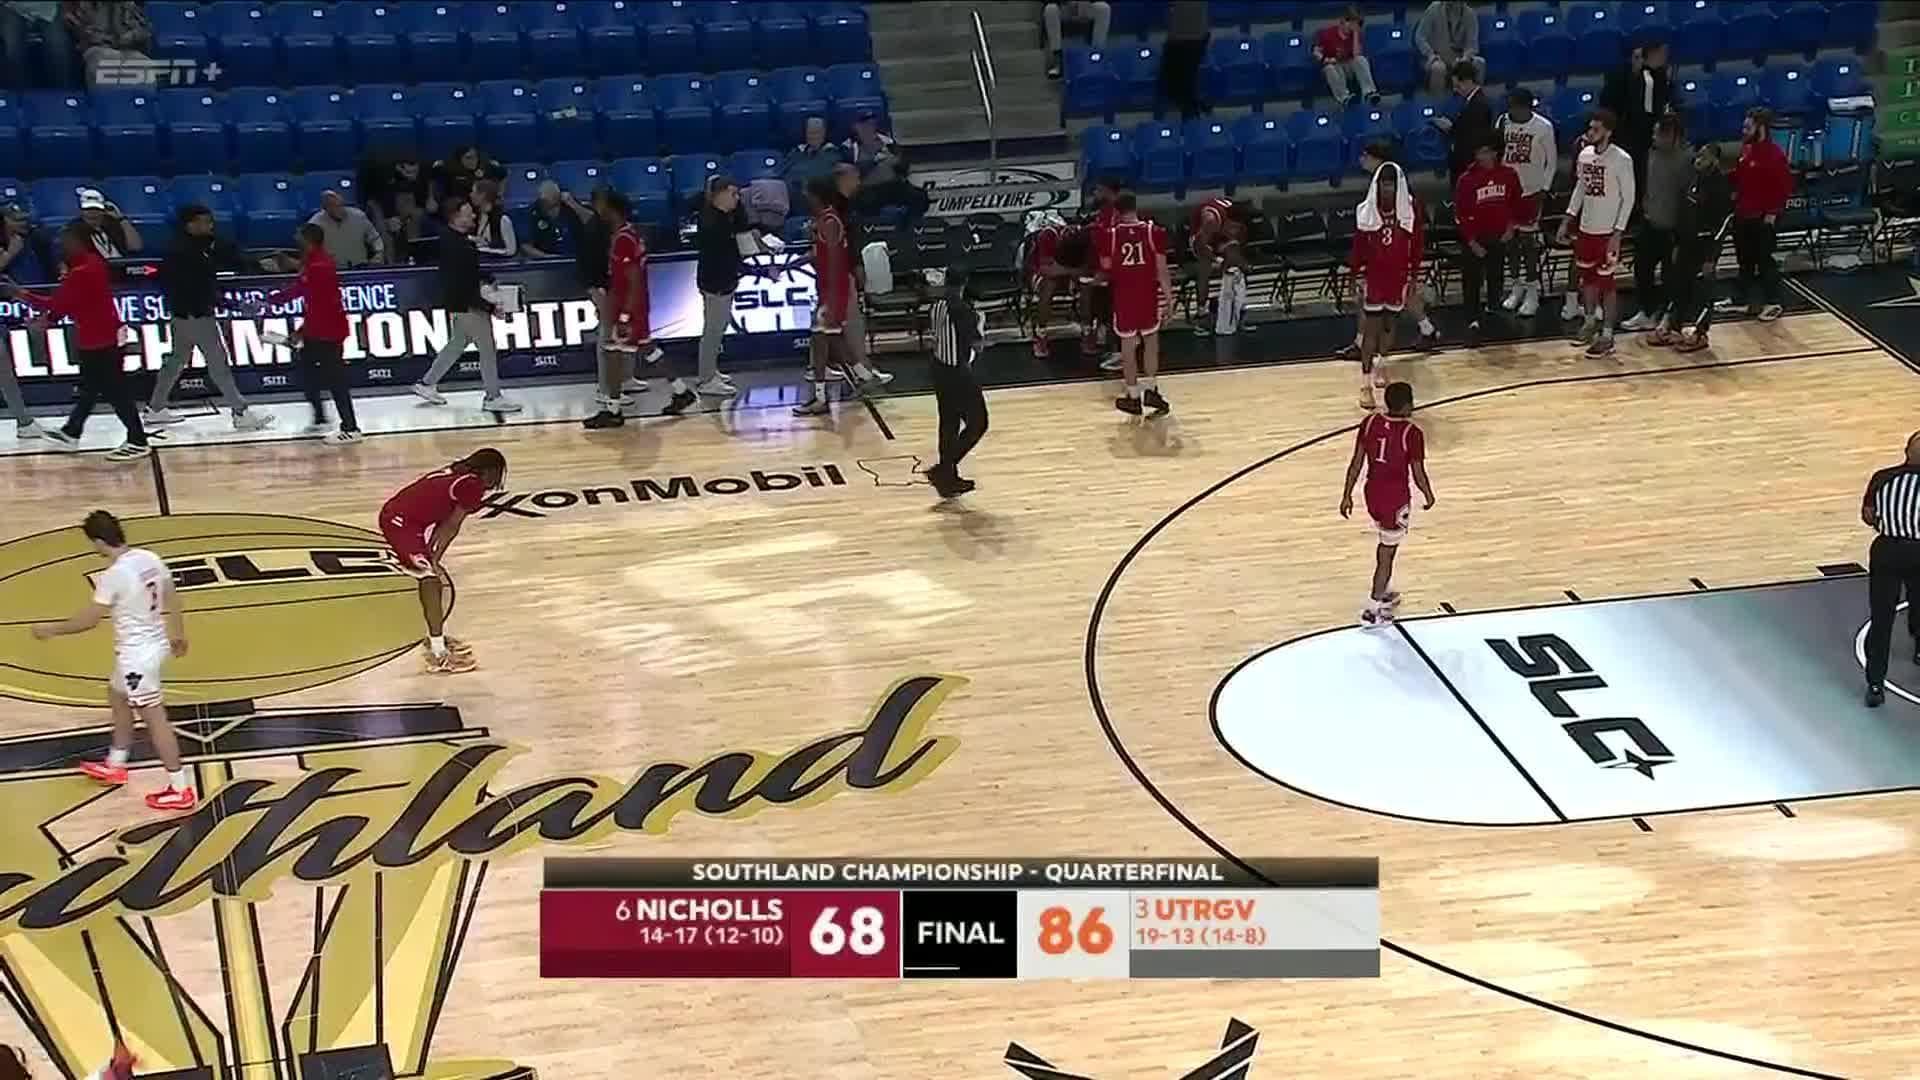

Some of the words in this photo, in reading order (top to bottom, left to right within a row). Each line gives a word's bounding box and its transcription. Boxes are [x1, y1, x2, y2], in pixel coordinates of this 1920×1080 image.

[1382, 228, 1393, 246] 3
[1121, 242, 1146, 266] 21
[734, 286, 812, 311] SLC
[1375, 437, 1387, 464] 1
[1484, 633, 1676, 766] SLC
